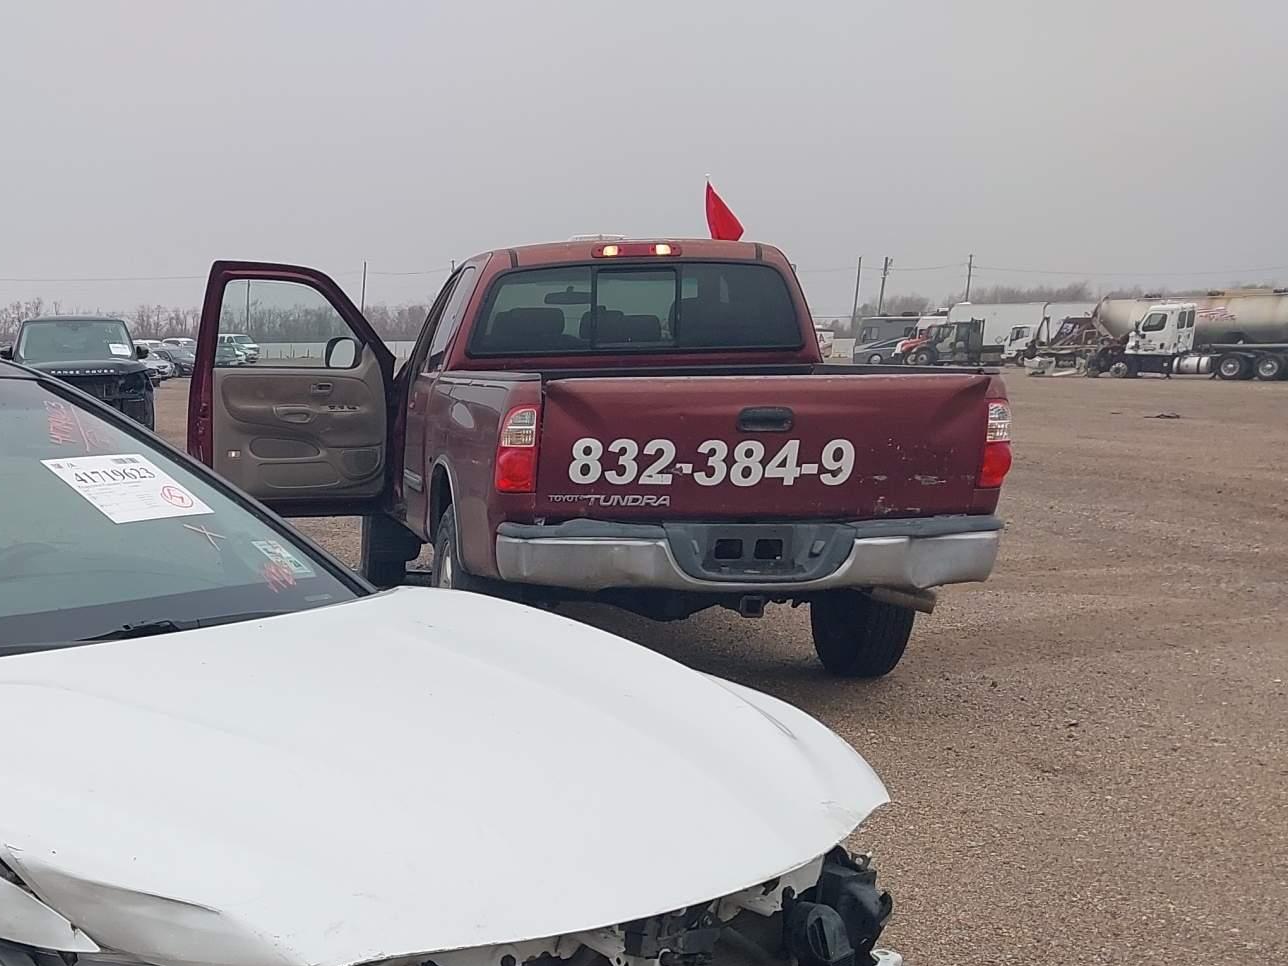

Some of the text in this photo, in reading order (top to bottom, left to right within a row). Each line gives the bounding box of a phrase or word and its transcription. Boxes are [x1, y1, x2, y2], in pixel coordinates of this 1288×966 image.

[569, 438, 855, 487] 832-384-9
[74, 467, 156, 484] 41719623
[583, 494, 671, 507] TUNDRA
